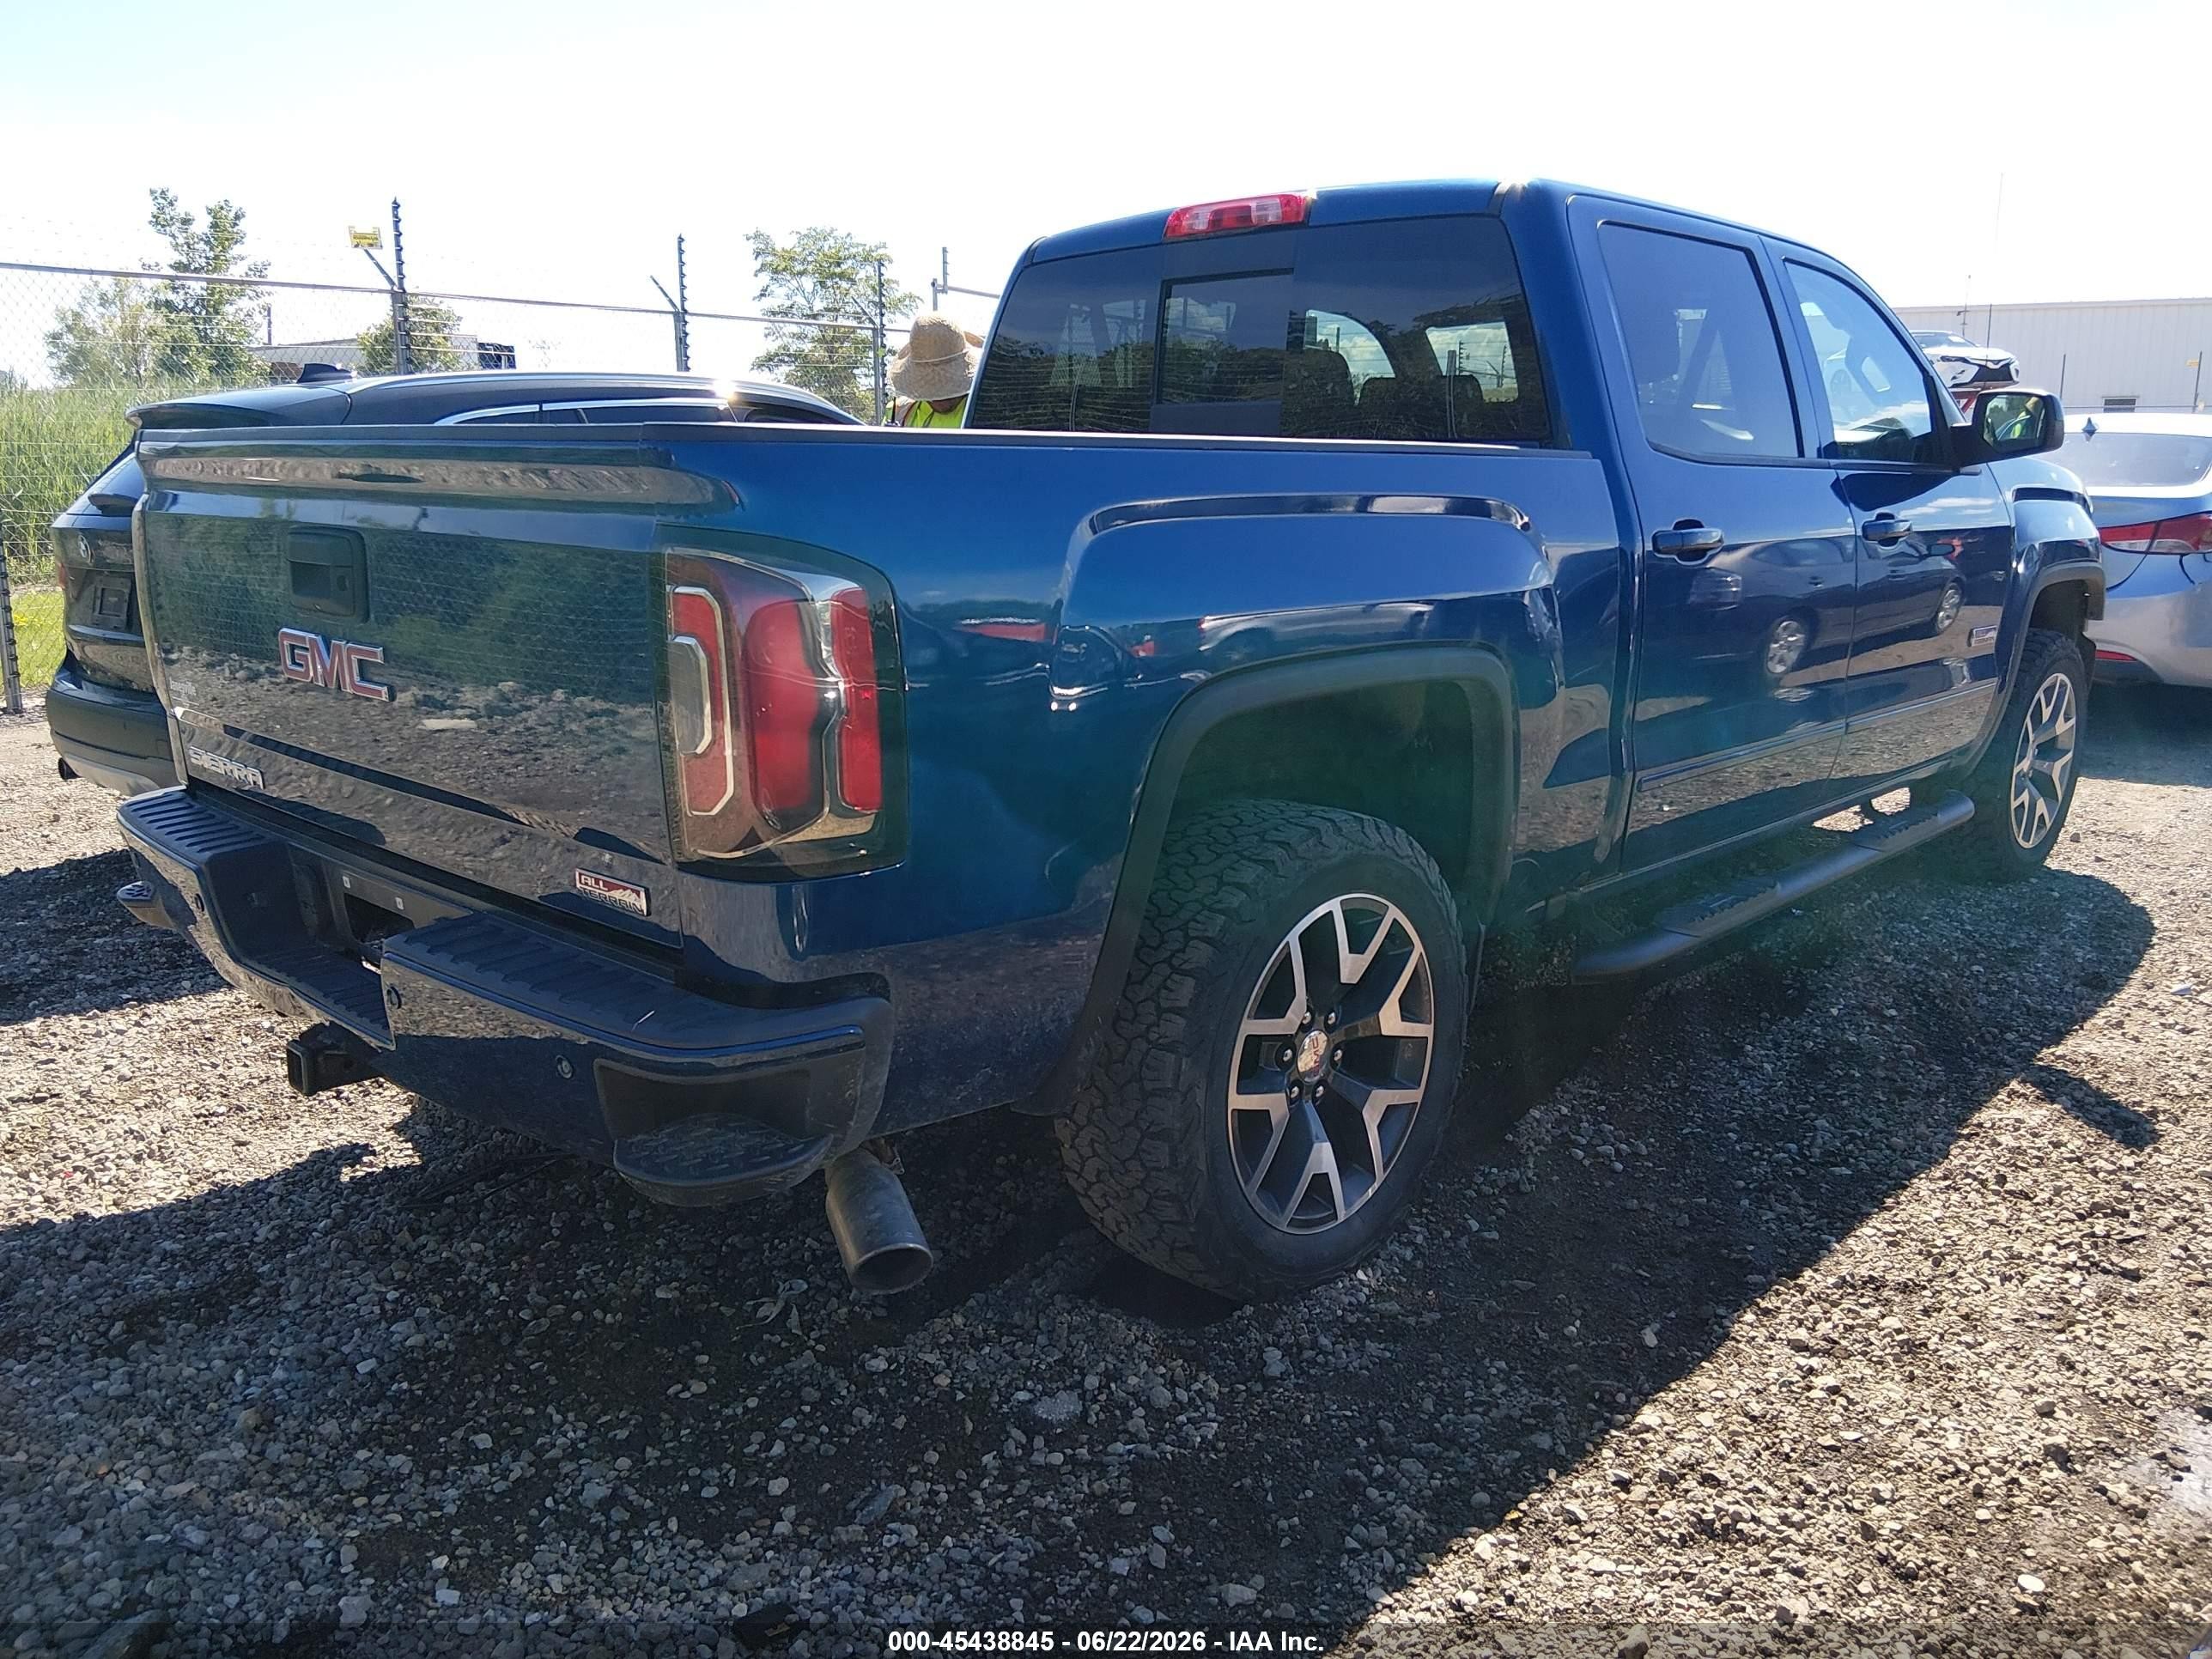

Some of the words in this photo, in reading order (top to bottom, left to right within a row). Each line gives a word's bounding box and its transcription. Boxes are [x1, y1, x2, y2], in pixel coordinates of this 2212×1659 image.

[278, 628, 390, 702] GMC
[189, 745, 264, 790] SIERRA
[579, 886, 644, 915] TERRAIN
[580, 875, 608, 891] ALL
